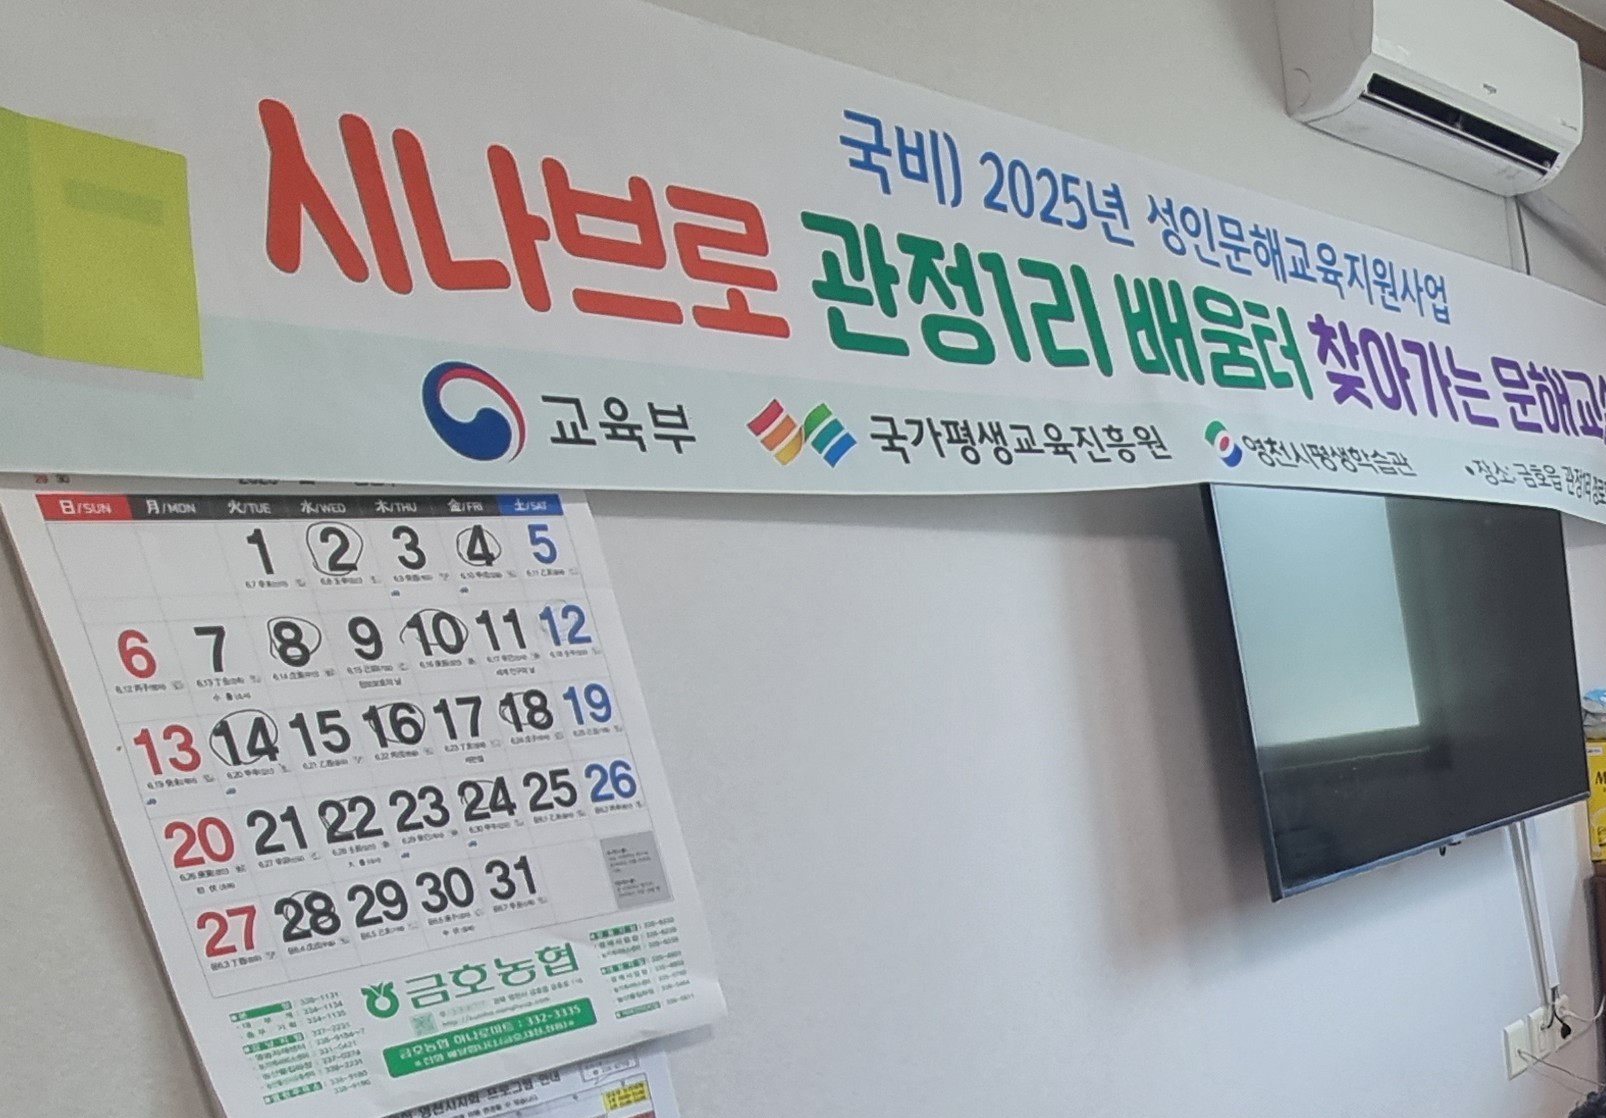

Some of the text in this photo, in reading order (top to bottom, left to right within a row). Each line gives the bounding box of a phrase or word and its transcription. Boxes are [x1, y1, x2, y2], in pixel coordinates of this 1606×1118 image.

[840, 108, 1452, 325] 국비) 2025년 성인문해교육지원사업
[258, 98, 791, 339] 시나브로
[800, 210, 1114, 378] 관정1리
[1112, 270, 1316, 401] 배움터
[1307, 312, 1492, 430] 찾아가는
[540, 394, 698, 456] 교육부
[869, 414, 1171, 467] 국가평생교육진흥원
[1242, 432, 1418, 479] 영천시평생학습관
[1512, 462, 1563, 492] 금호읍
[246, 528, 275, 575] 1
[320, 526, 358, 571] 2
[392, 525, 427, 570] 3
[466, 525, 495, 566] 4
[527, 524, 558, 564] 5
[193, 625, 226, 673] 7
[273, 620, 311, 667] 8
[347, 616, 384, 661] 9
[406, 611, 465, 656] 10
[475, 608, 527, 652] 11
[538, 604, 593, 647] 12
[118, 629, 157, 679] 6
[361, 701, 424, 748] 16
[433, 695, 483, 741] 17
[500, 689, 554, 733] 18
[562, 683, 613, 726] 19
[133, 724, 202, 776] 13
[212, 716, 280, 766] 14
[288, 709, 352, 757] 15
[457, 776, 517, 822] 24
[522, 768, 578, 813] 25
[584, 759, 638, 803] 26
[246, 805, 309, 856] 21
[317, 795, 384, 844] 22
[388, 785, 451, 833] 23
[164, 816, 236, 869] 20
[415, 866, 475, 914] 30
[484, 855, 537, 900] 31
[273, 890, 342, 943] 28
[347, 878, 408, 928] 29
[196, 904, 257, 958] 27
[404, 940, 581, 1011] 금호농협
